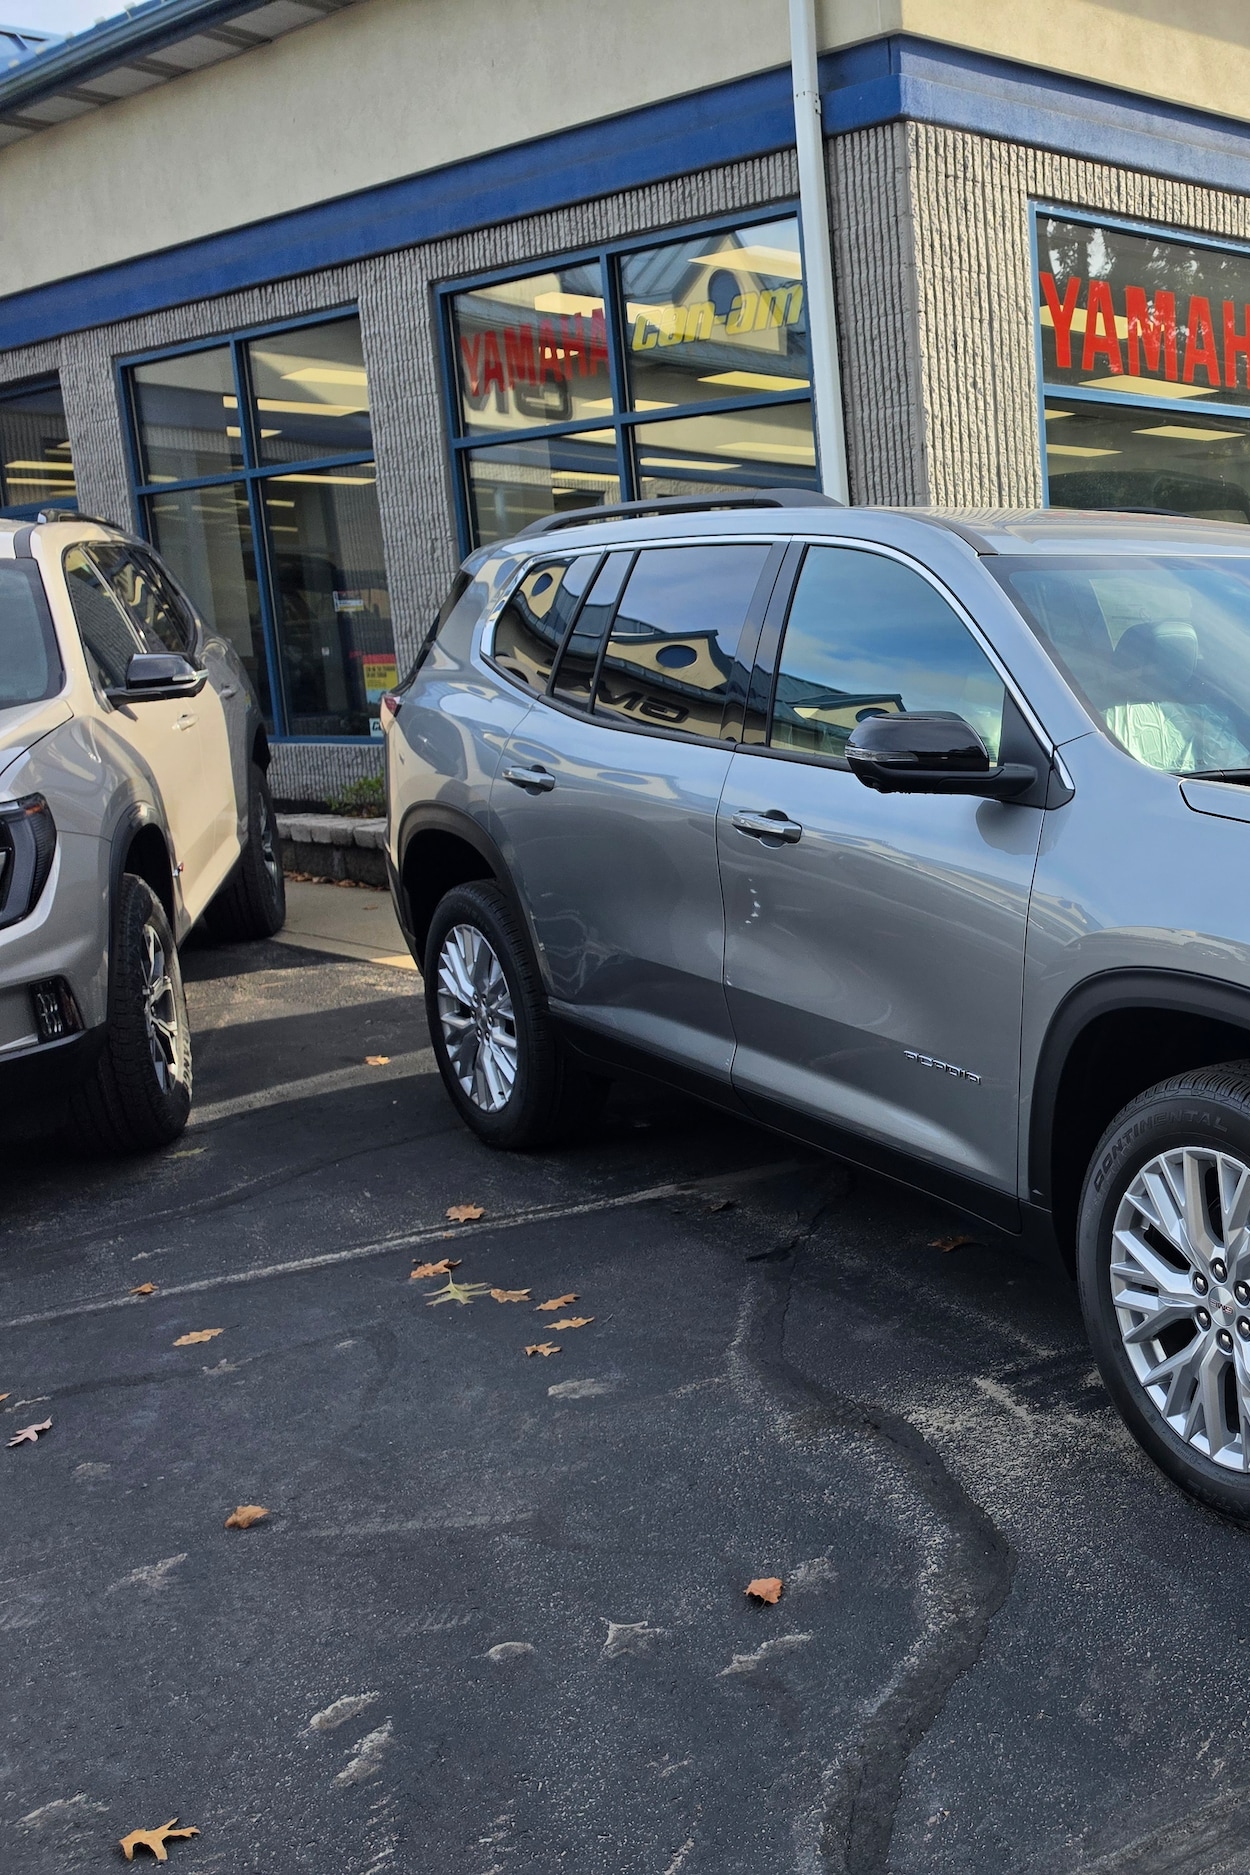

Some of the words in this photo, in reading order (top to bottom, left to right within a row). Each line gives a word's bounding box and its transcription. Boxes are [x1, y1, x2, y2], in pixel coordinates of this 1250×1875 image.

[460, 307, 609, 397] YAMAHA
[630, 282, 803, 351] can-am
[1093, 1109, 1228, 1193] CONTINENTAL
